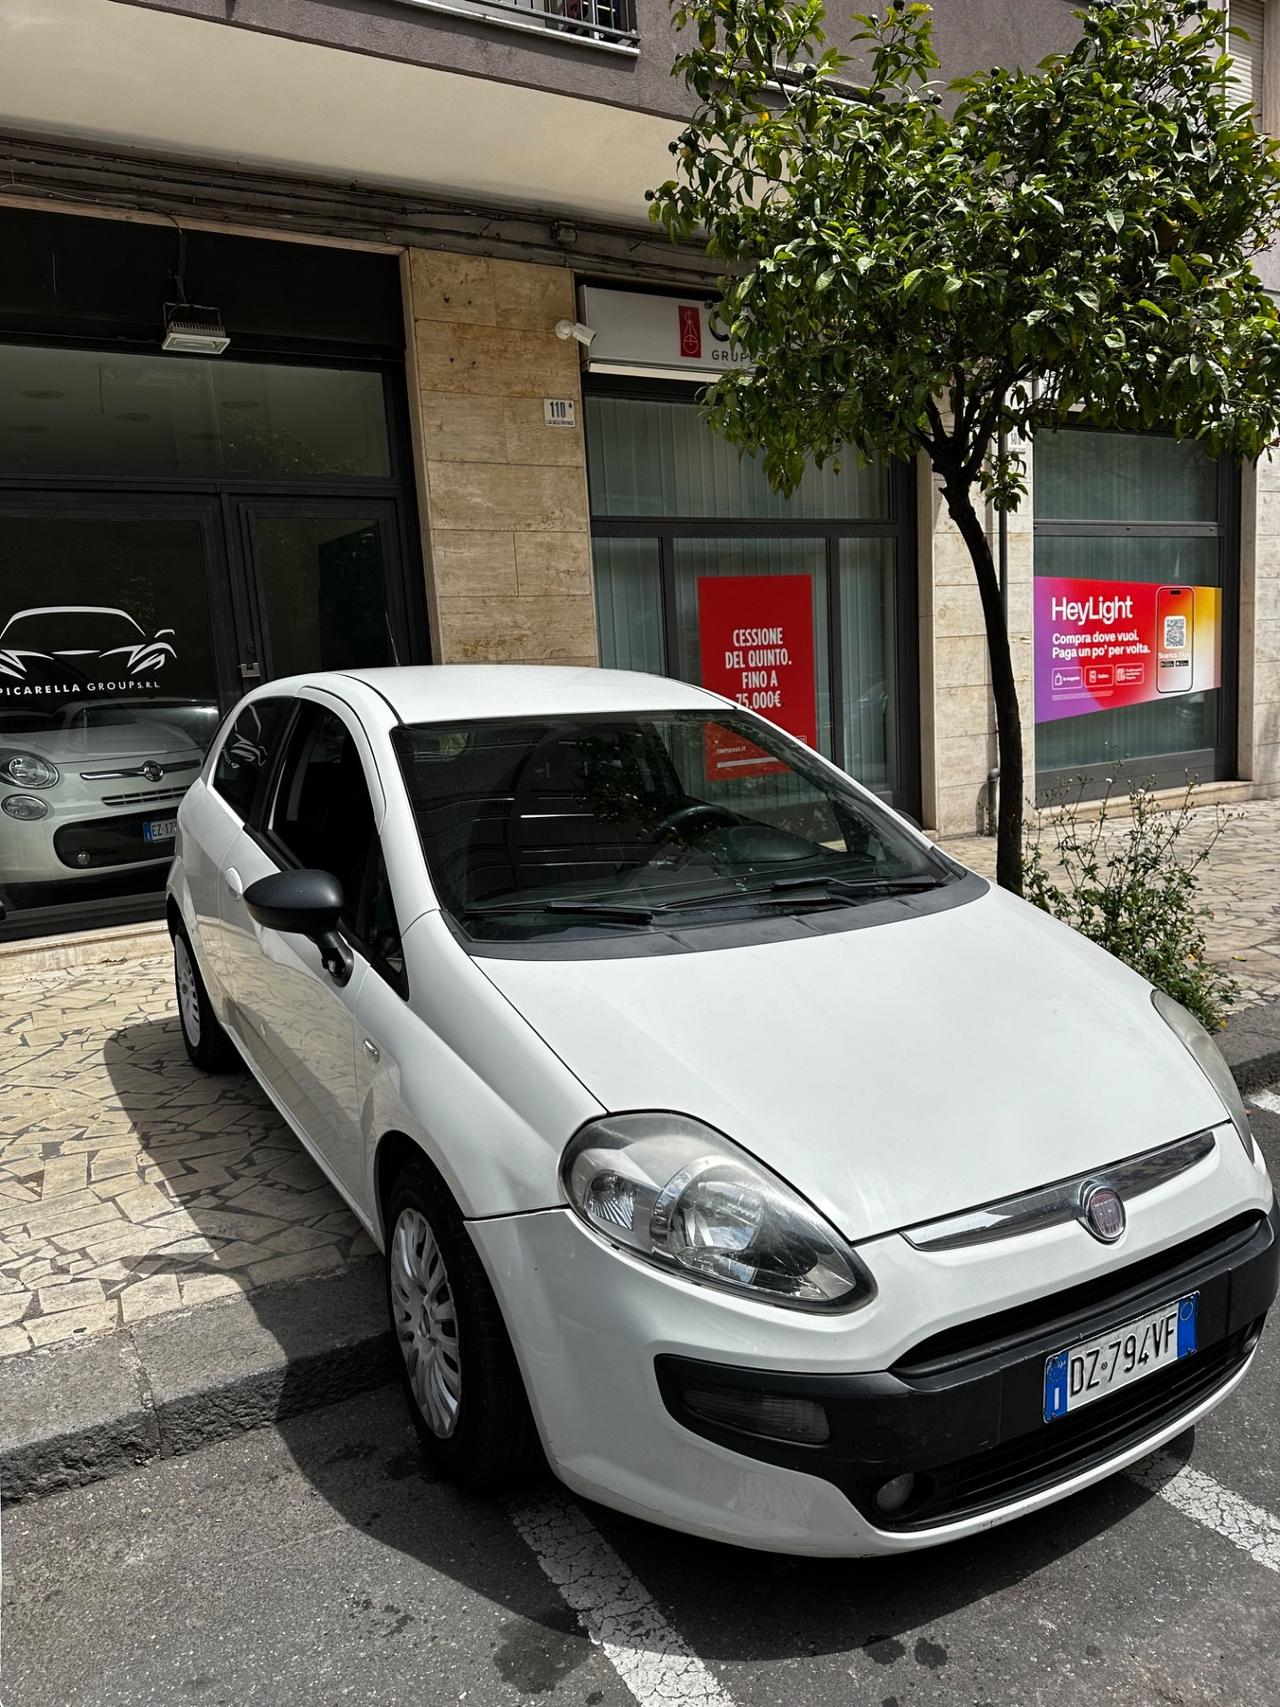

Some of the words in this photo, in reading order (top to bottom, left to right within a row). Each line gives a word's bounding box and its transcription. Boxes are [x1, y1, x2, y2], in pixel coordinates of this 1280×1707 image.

[549, 401, 567, 418] 110
[1051, 595, 1133, 625] HeyLight
[732, 627, 783, 647] CESSIONE
[1052, 633, 1091, 647] Compra
[1093, 631, 1116, 643] dove
[1116, 629, 1139, 641] vuoi.
[725, 651, 746, 669] DEL
[748, 648, 792, 667] QUINTO.
[1052, 648, 1077, 661] Paga
[1079, 648, 1091, 658] un
[1091, 645, 1108, 659] po'
[1108, 646, 1125, 659] per
[1125, 643, 1151, 655] volta.
[87, 681, 136, 692] GROUP
[742, 670, 767, 689] FINO
[770, 670, 778, 687] A
[736, 691, 781, 710] 75.000€
